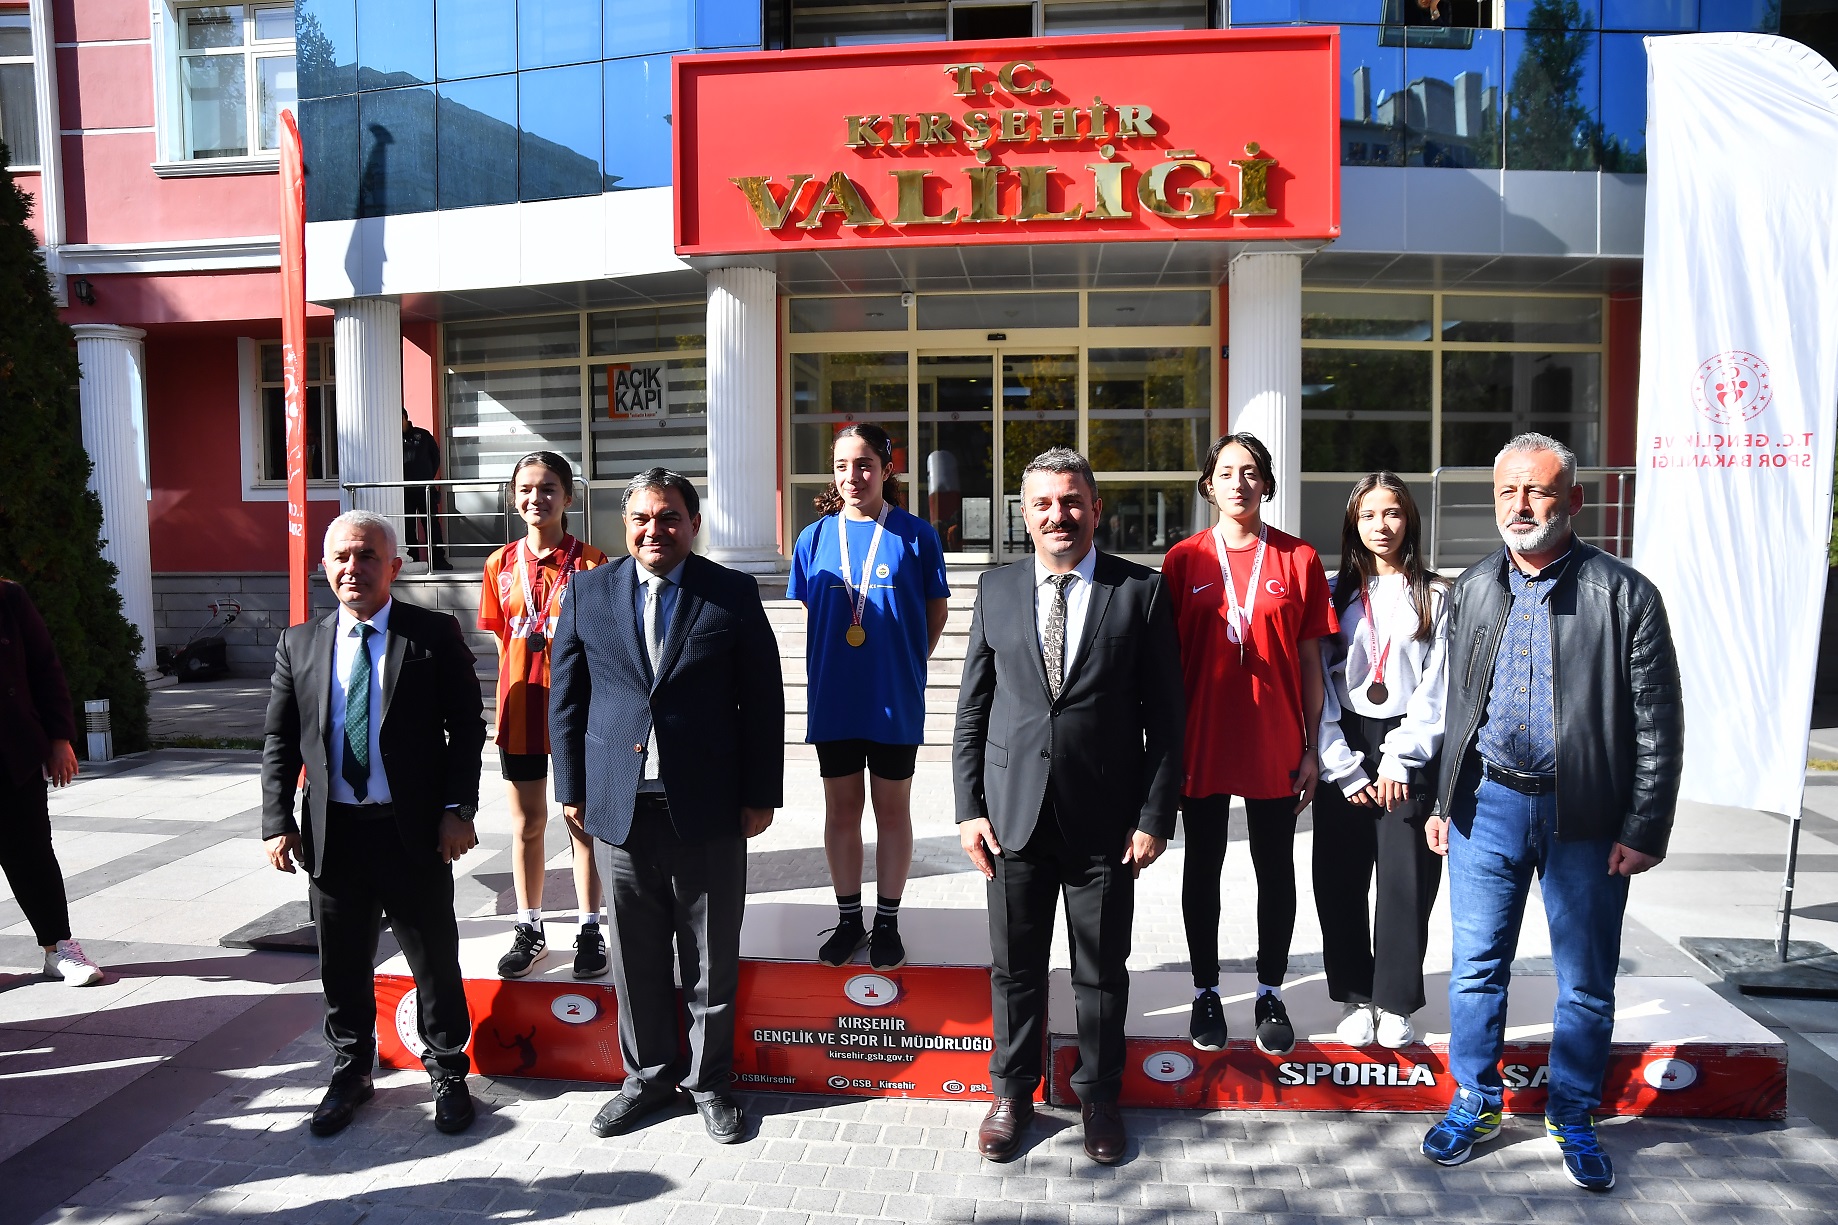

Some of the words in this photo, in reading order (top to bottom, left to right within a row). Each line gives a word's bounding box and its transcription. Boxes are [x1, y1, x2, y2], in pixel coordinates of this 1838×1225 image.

[943, 60, 1053, 97] T.C.
[844, 95, 1159, 149] KIRŞEHİR
[728, 142, 1281, 231] VALİLİĞİ
[615, 367, 662, 391] AÇIK
[615, 388, 662, 412] KAPI
[863, 983, 879, 998] 1
[567, 1003, 581, 1016] 2
[838, 1016, 906, 1032] KIRŞEHİR
[753, 1029, 814, 1045] GENÇLİK
[818, 1031, 836, 1045] VE
[840, 1033, 879, 1048] SPOR
[883, 1033, 897, 1048] İL
[829, 1050, 914, 1063] kirsehir.gsb.gov.tr
[1160, 1060, 1176, 1073] 3
[1278, 1062, 1436, 1086] SPORLA
[1662, 1068, 1678, 1082] 4
[741, 1073, 797, 1085] GSBKirsehir
